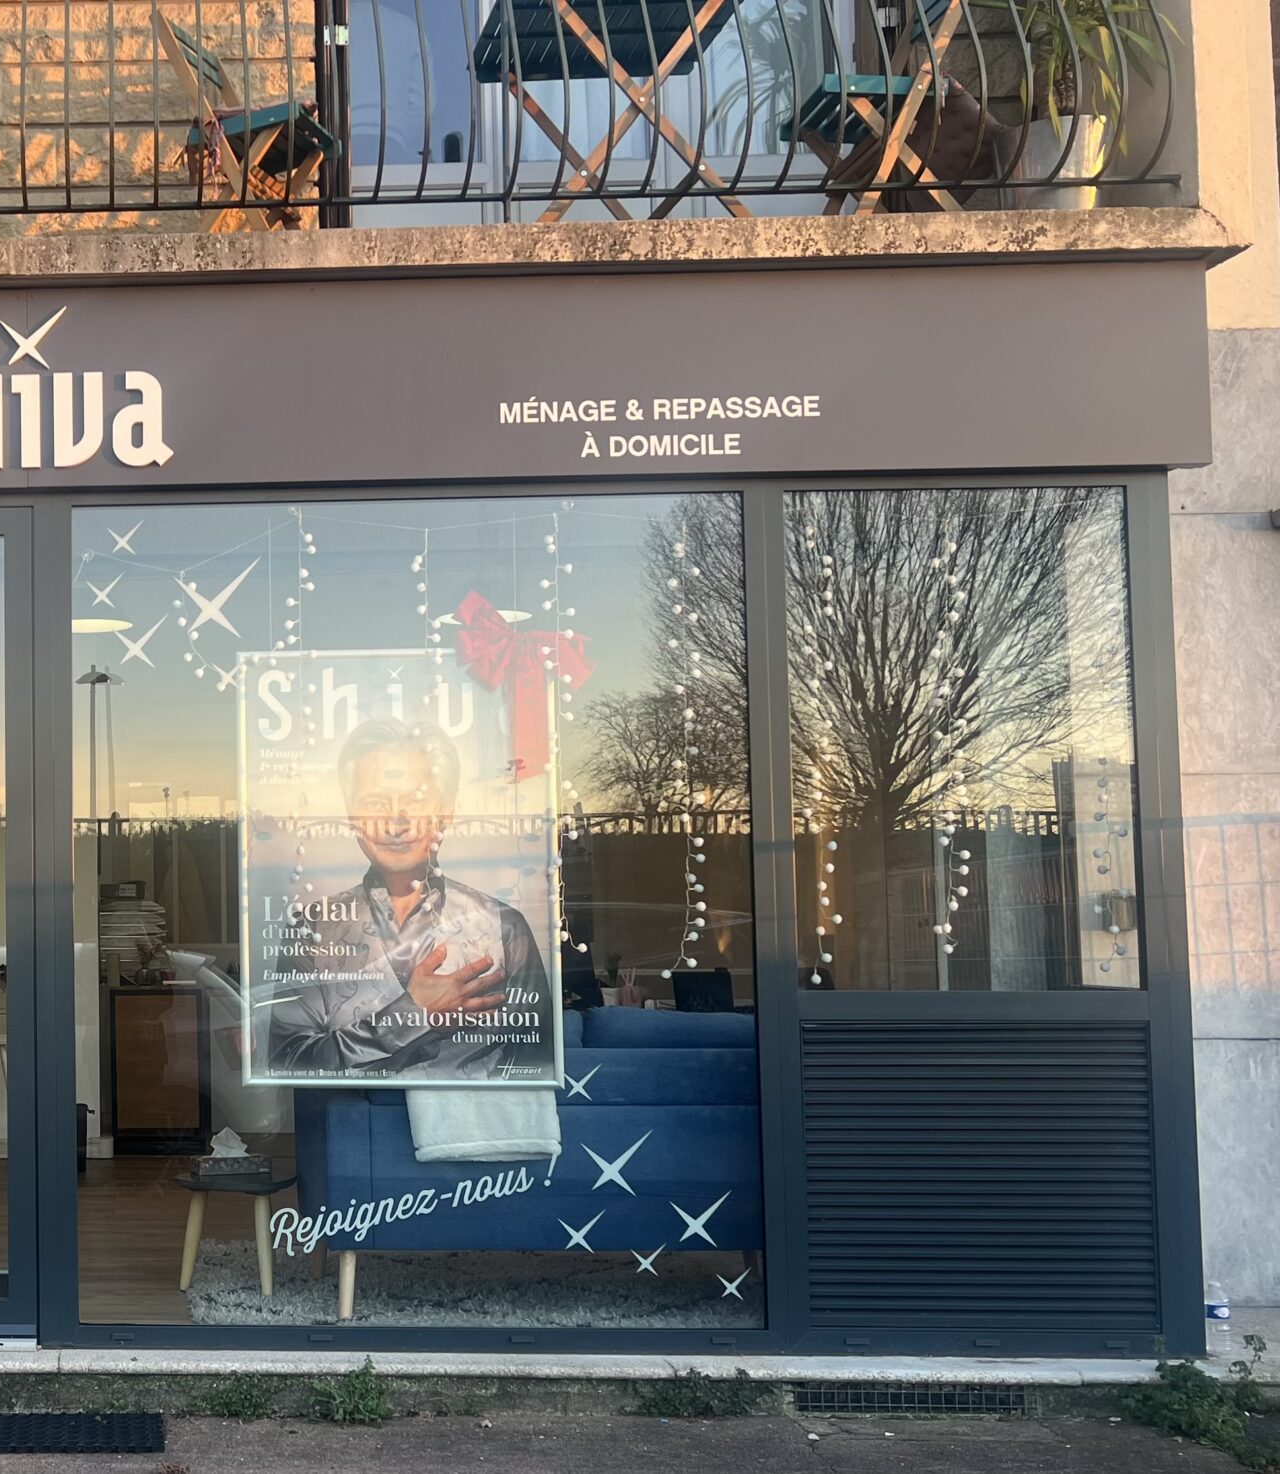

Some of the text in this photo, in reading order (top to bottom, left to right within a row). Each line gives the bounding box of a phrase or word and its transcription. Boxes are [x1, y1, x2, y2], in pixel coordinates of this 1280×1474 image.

[499, 395, 821, 424] MÉNAGE & REPASSAGE
[580, 431, 741, 458] À DOMICILE
[263, 941, 357, 960] profession
[263, 969, 385, 984] Employé de maison
[505, 987, 539, 1004] Tho
[371, 1006, 540, 1027] La valorisation
[452, 1031, 540, 1045] d'un portrait
[270, 1152, 559, 1257] Rejoignez-nous !
